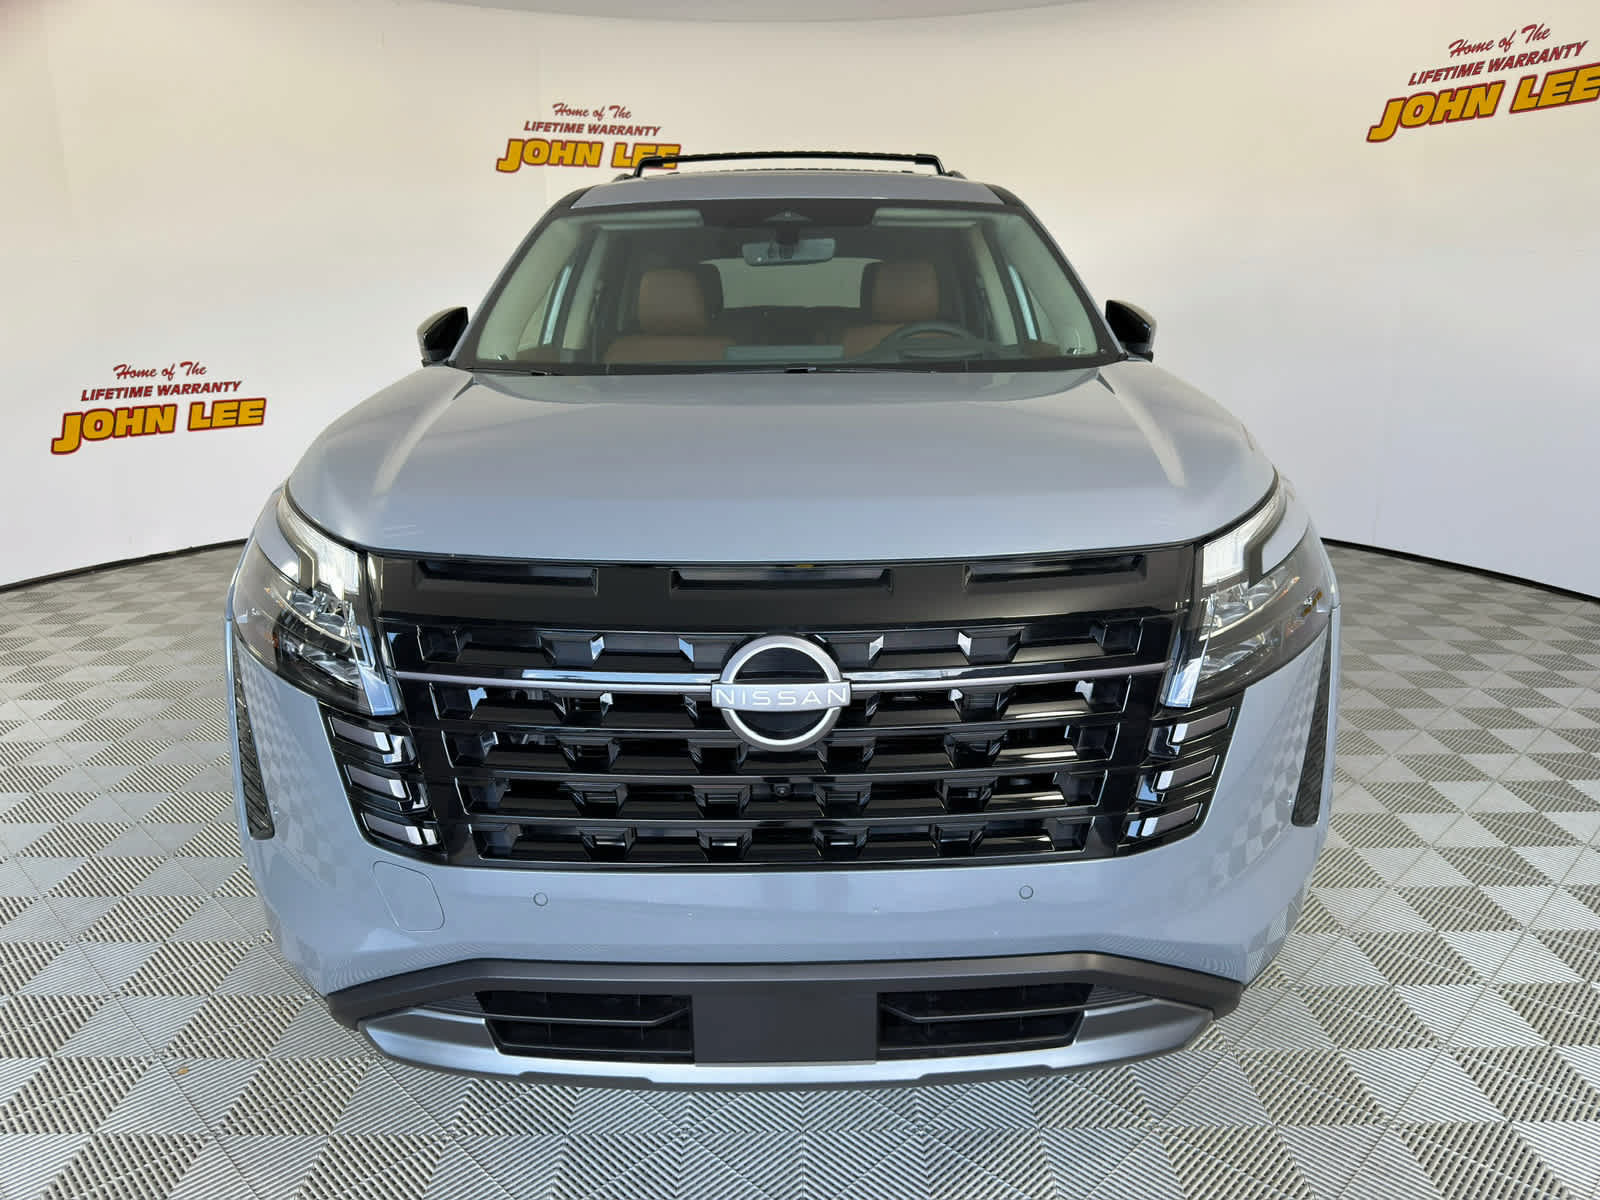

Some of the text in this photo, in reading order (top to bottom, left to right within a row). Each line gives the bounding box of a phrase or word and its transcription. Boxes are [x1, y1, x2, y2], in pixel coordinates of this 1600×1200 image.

[1448, 23, 1551, 58] Home of The
[1408, 40, 1589, 86] LIFETIME WARRANTY
[552, 102, 632, 121] Home of The
[1366, 62, 1600, 143] JOHN LEE
[523, 121, 661, 136] LIFETIME WARRANTY
[496, 138, 604, 173] JOHN
[113, 361, 207, 382] Home of The
[80, 380, 242, 402] LIFETIME WARRANTY
[50, 397, 267, 455] JOHN LEE
[715, 688, 847, 706] NISSAN
